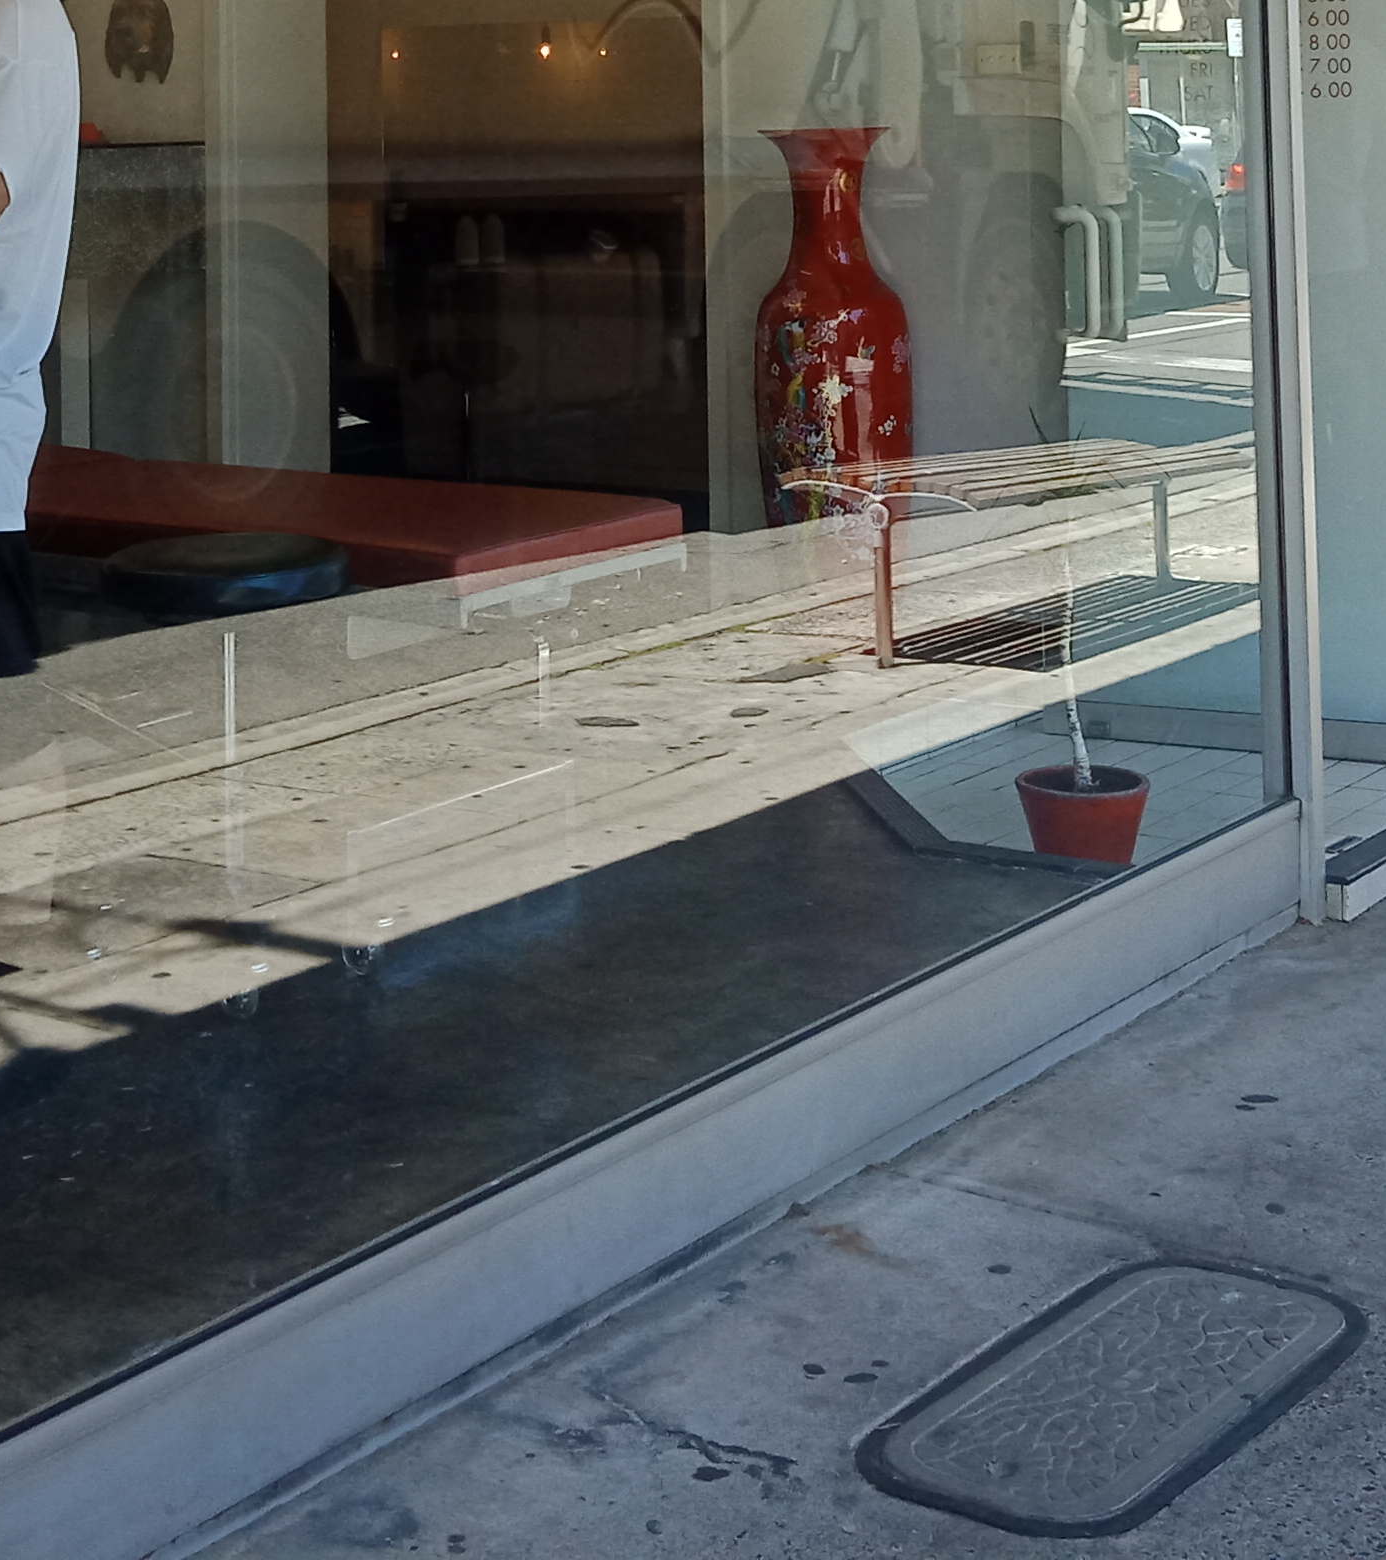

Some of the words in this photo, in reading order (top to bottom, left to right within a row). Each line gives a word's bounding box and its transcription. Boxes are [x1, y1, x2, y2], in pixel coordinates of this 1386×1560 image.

[1307, 9, 1351, 27] 6.00
[1309, 33, 1351, 51] 8.00
[1309, 57, 1352, 74] 7.00
[1310, 81, 1353, 99] 6.00
